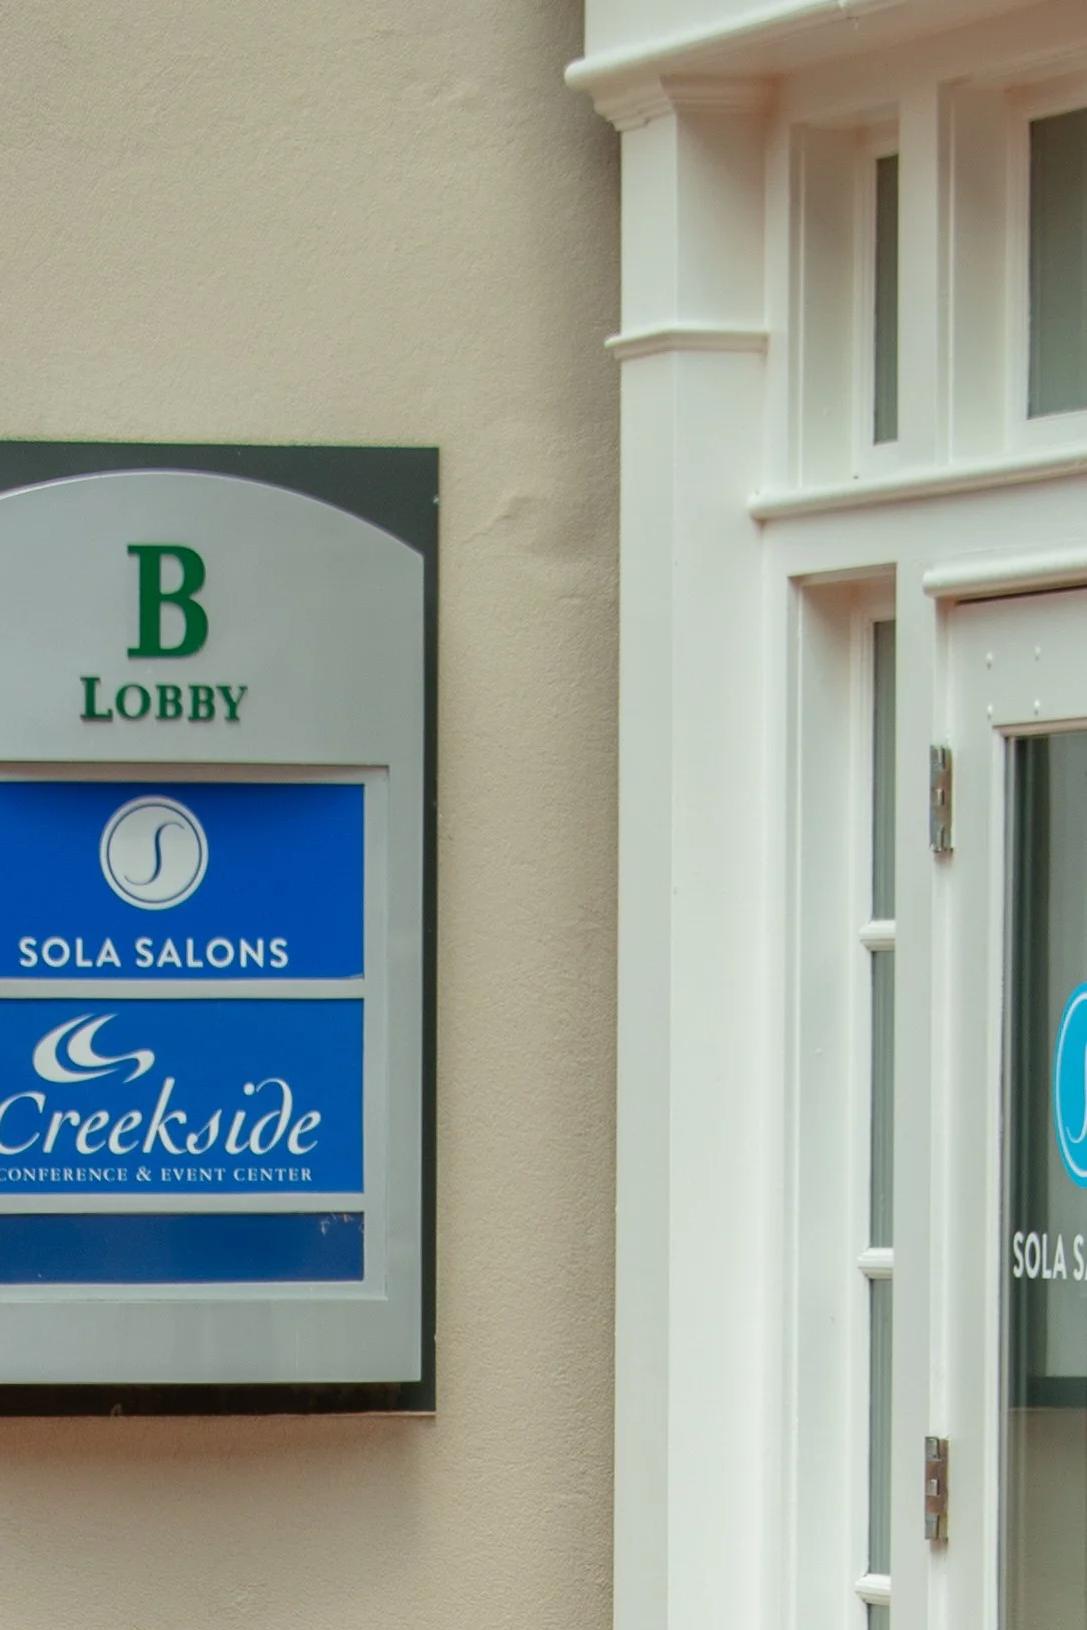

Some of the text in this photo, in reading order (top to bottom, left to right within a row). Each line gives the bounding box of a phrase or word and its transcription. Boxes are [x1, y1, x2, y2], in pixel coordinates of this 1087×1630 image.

[126, 544, 210, 660] B
[79, 676, 248, 723] LOBBY
[18, 936, 289, 969] SOLA SALONS
[135, 1165, 152, 1183] &
[160, 1166, 227, 1183] EVENT
[233, 1166, 313, 1183] CENTER
[1013, 1231, 1087, 1282] SOLA S
